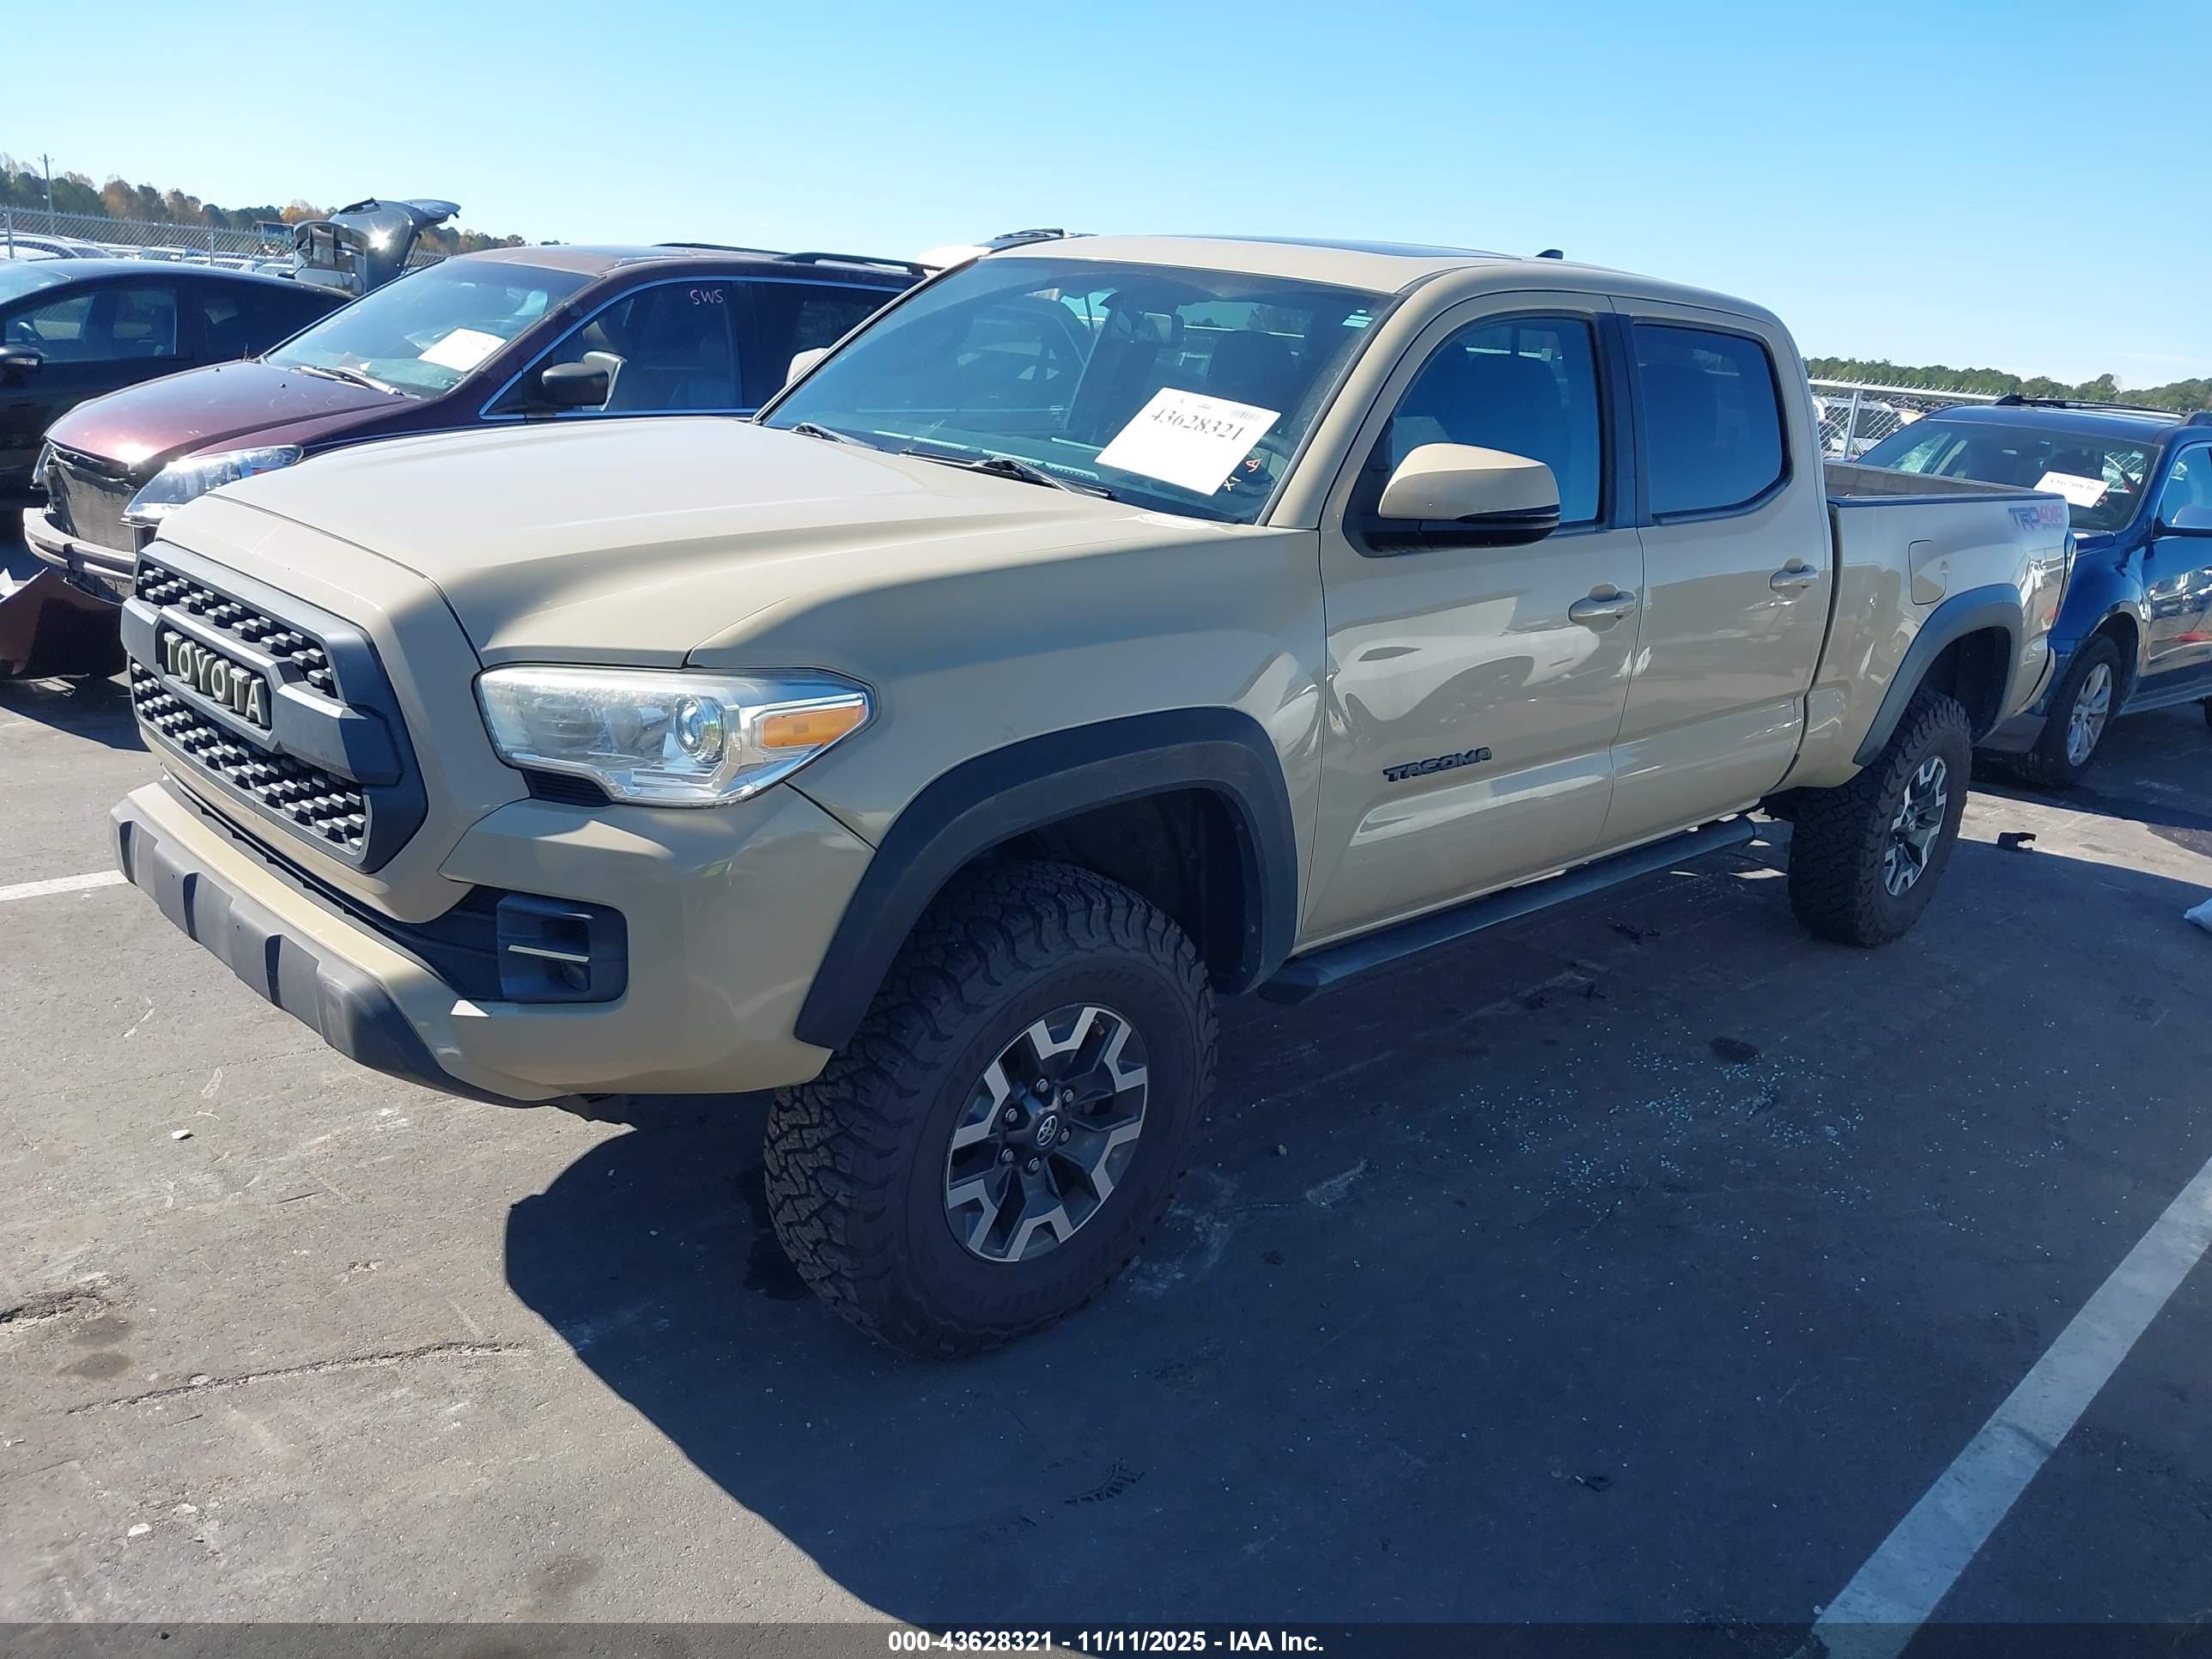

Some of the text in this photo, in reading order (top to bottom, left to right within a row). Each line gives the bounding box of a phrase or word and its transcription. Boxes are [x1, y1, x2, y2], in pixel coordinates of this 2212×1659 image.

[1151, 408, 1244, 441] 43628321
[164, 631, 269, 726] TOYOTA
[1382, 746, 1492, 782] TACOMA
